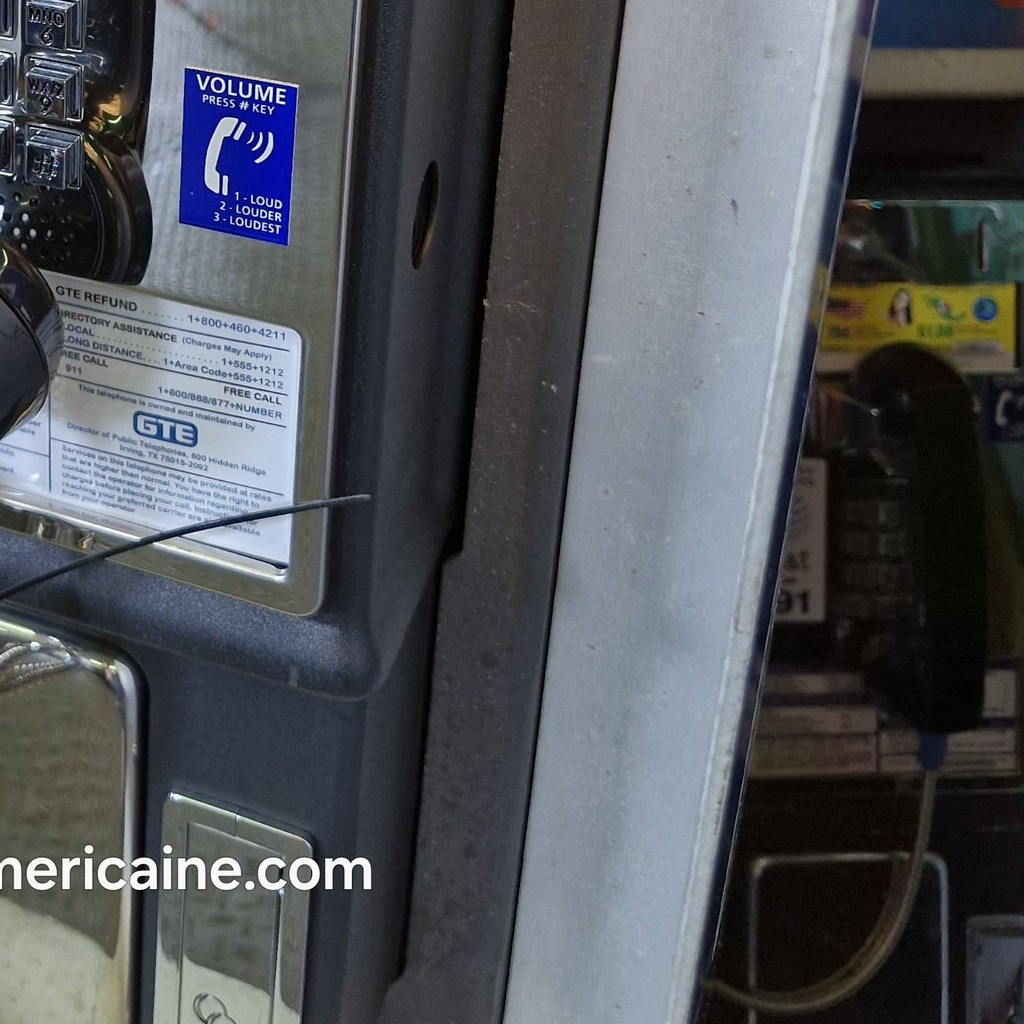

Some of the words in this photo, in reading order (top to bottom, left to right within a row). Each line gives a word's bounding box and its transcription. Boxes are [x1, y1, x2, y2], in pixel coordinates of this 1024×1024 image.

[29, 6, 65, 28] MNO
[40, 27, 54, 46] 6
[38, 95, 53, 116] 9
[196, 73, 287, 106] VOLUME
[202, 94, 236, 109] PRESS
[239, 101, 249, 111] #
[252, 103, 275, 116] KEY
[219, 201, 226, 211] 2
[236, 204, 282, 222] LOUDER
[234, 192, 240, 201] 1
[250, 194, 283, 210] LOUD
[213, 212, 220, 222] 3
[229, 216, 282, 235] LOUDEST
[56, 285, 81, 300] GTE
[84, 291, 138, 312] REFUND
[188, 314, 286, 341] 1+800+460+4211
[61, 309, 111, 328] IRECTORY
[112, 321, 178, 343] ASSISTANCE
[182, 336, 222, 351] (Charges
[224, 344, 242, 356] May
[244, 348, 272, 362] Apply)
[83, 354, 109, 368] CALL
[223, 385, 252, 400] FREE
[253, 392, 283, 406] CALL
[92, 341, 143, 360] DISTANCE
[163, 357, 198, 373] 1+Area
[201, 365, 284, 390] Code+555+1212
[222, 357, 284, 377] 1+555+1212
[65, 363, 82, 375] 911
[158, 385, 283, 420] 1+800/888/877+NUMBER
[79, 383, 95, 395] This
[96, 387, 137, 405] telephone
[138, 399, 146, 407] is
[147, 402, 176, 414] owned
[177, 408, 194, 417] and
[195, 412, 243, 429] maintained
[245, 422, 256, 433] by
[135, 413, 196, 446] GTE
[67, 422, 100, 436] Director
[112, 433, 138, 446] Public
[241, 463, 267, 477] Ridge
